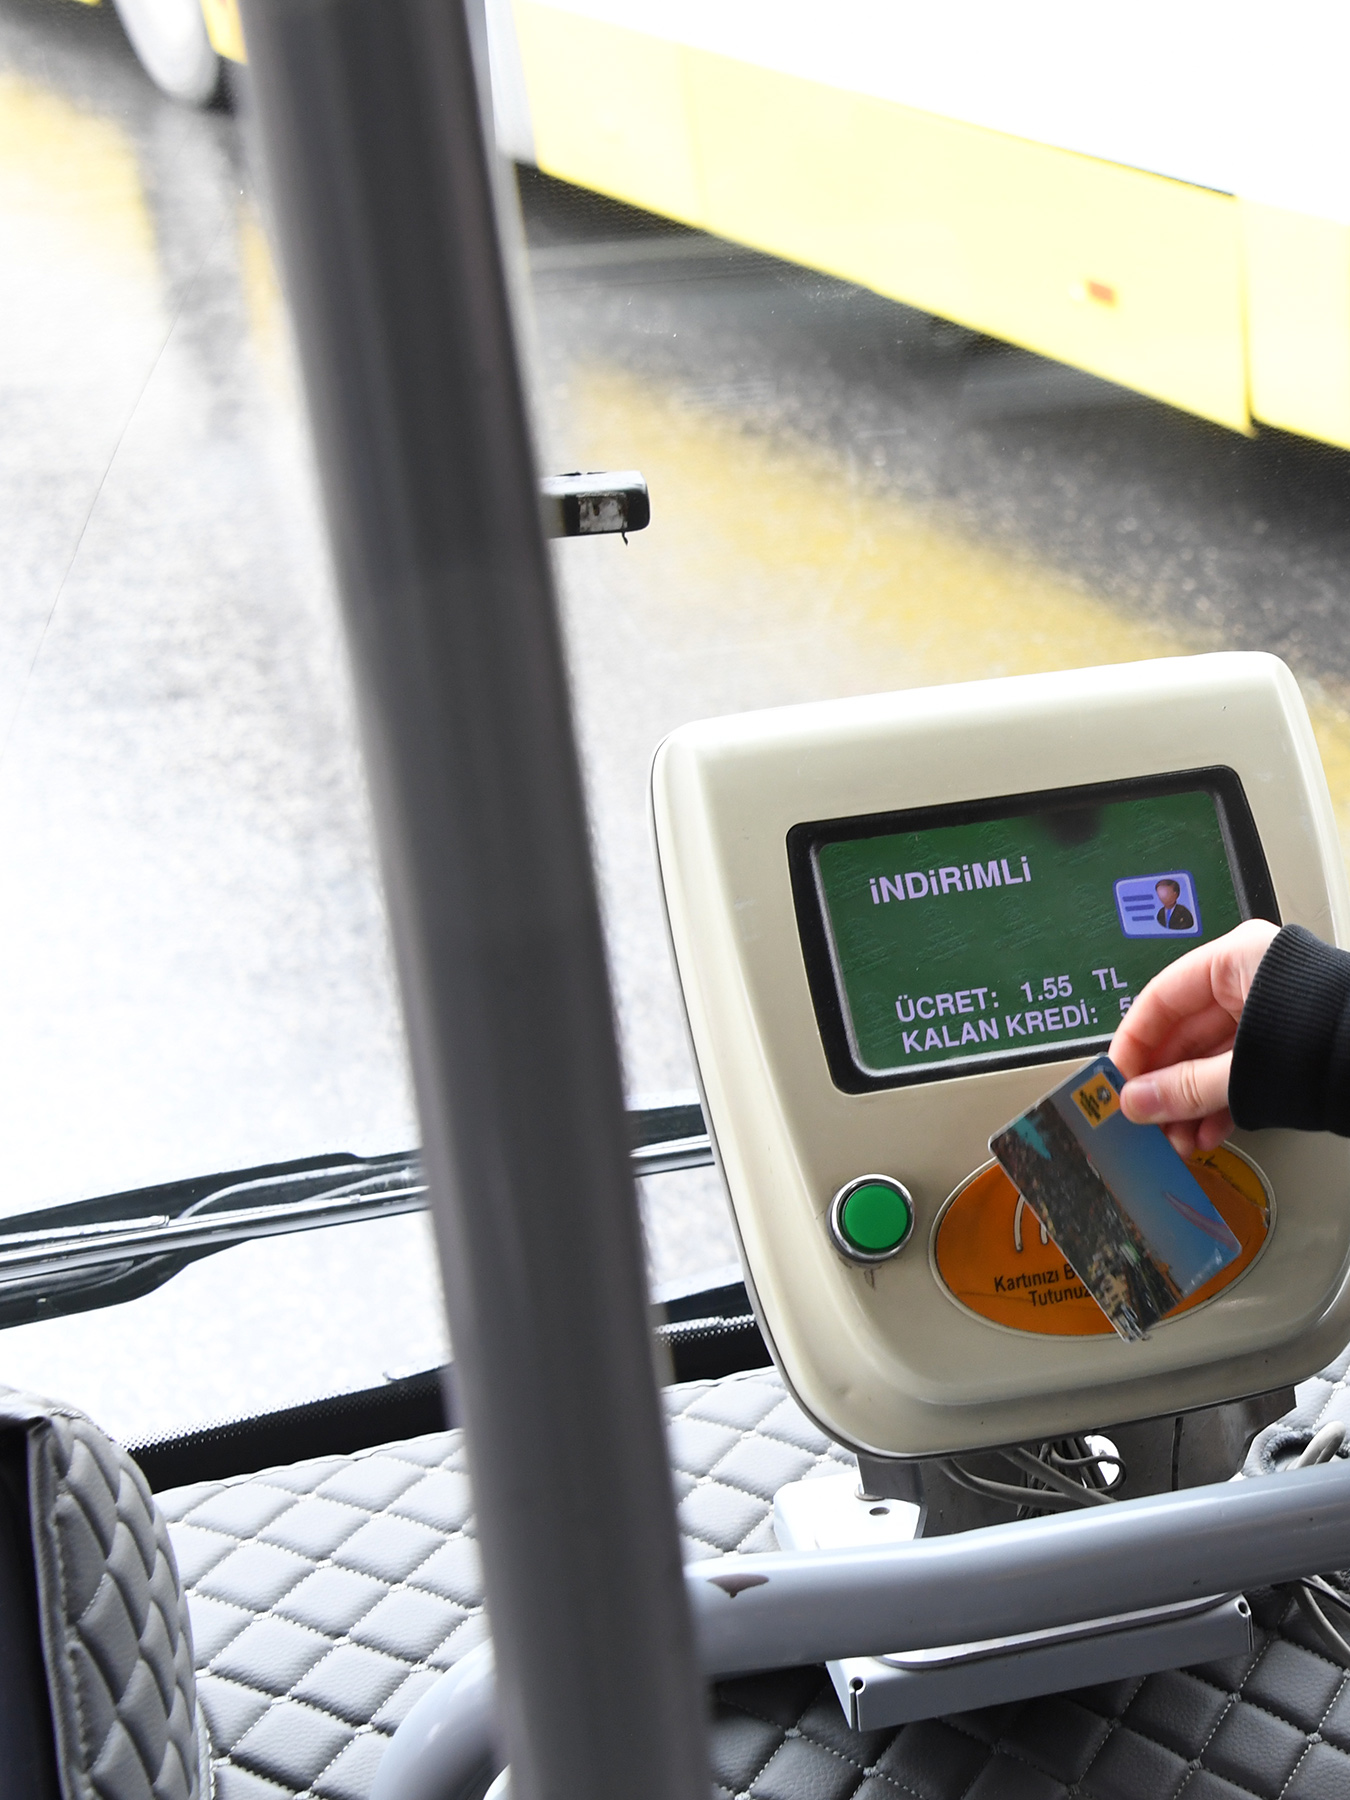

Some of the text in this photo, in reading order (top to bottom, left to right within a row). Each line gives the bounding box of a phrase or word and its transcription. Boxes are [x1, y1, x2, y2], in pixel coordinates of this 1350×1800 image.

[895, 967, 1128, 1023] ÜCRET: 1.55 TL
[902, 1018, 1000, 1054] KALAN
[1028, 1285, 1092, 1307] Tutunuz
